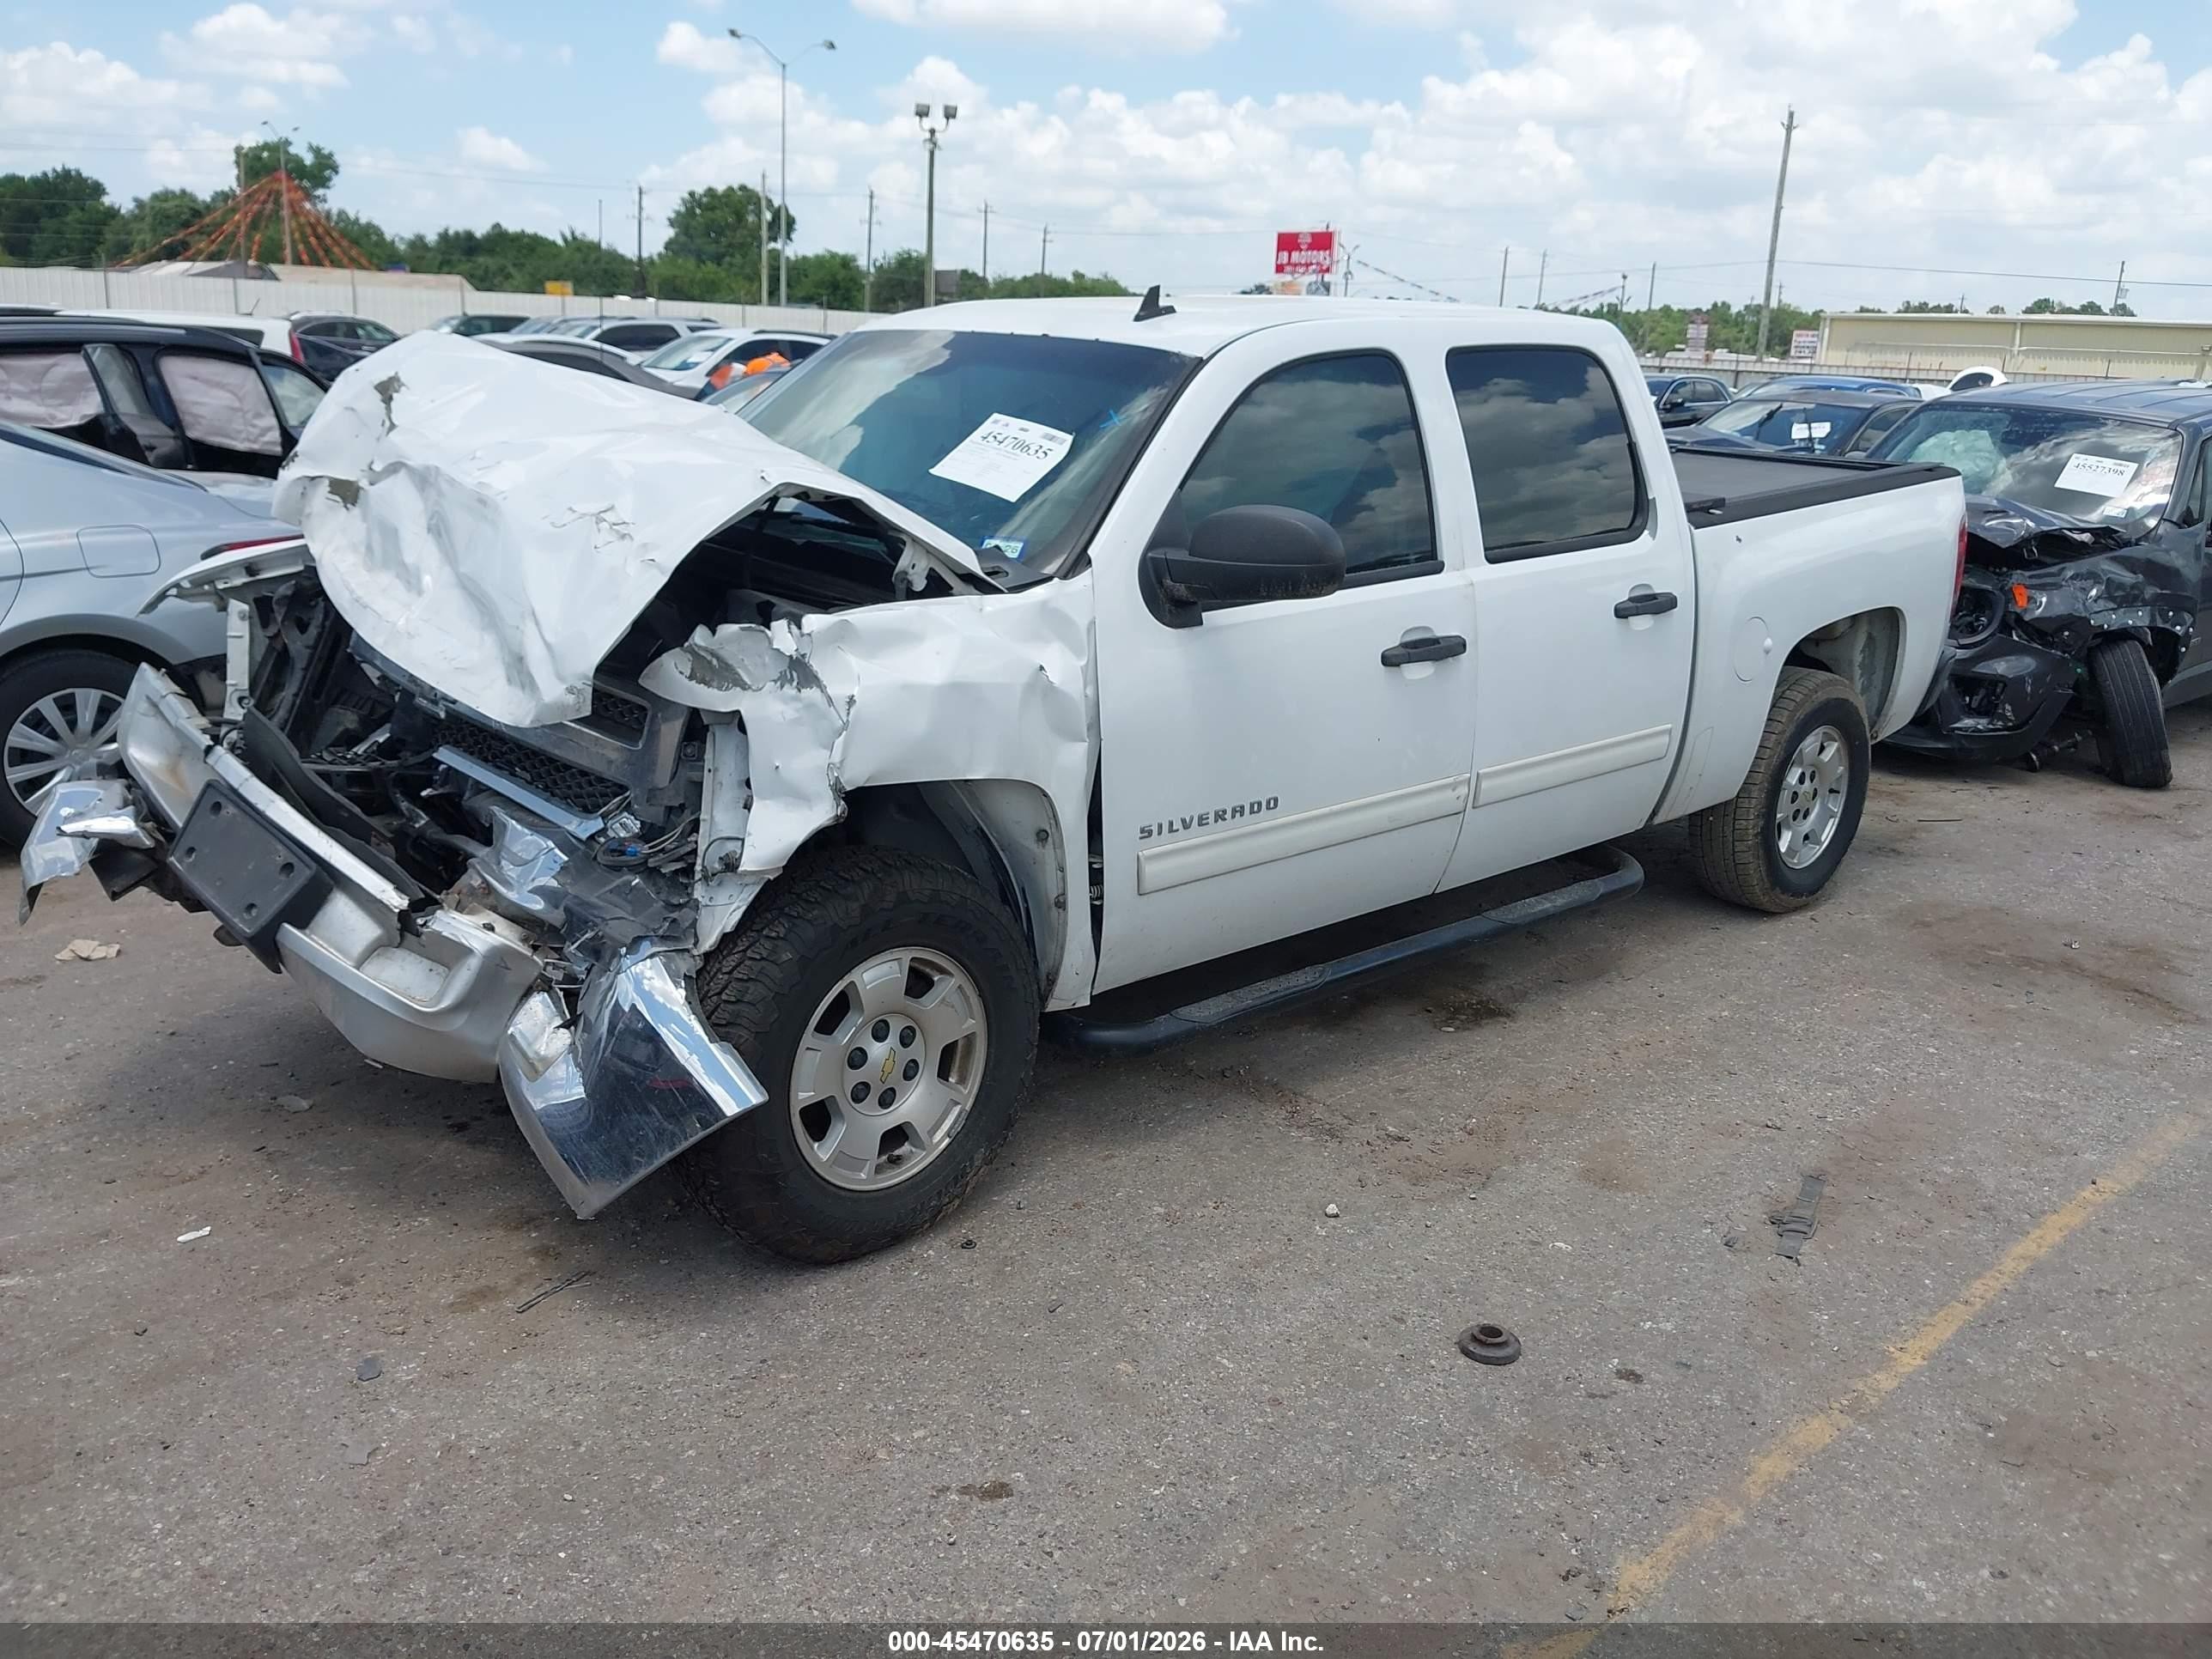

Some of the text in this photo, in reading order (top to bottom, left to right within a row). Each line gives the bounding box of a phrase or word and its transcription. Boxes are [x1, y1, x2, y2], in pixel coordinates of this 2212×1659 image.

[980, 430, 1054, 460] 45470635
[2073, 462, 2126, 477] 45527398
[1139, 795, 1279, 841] SILVERADO
